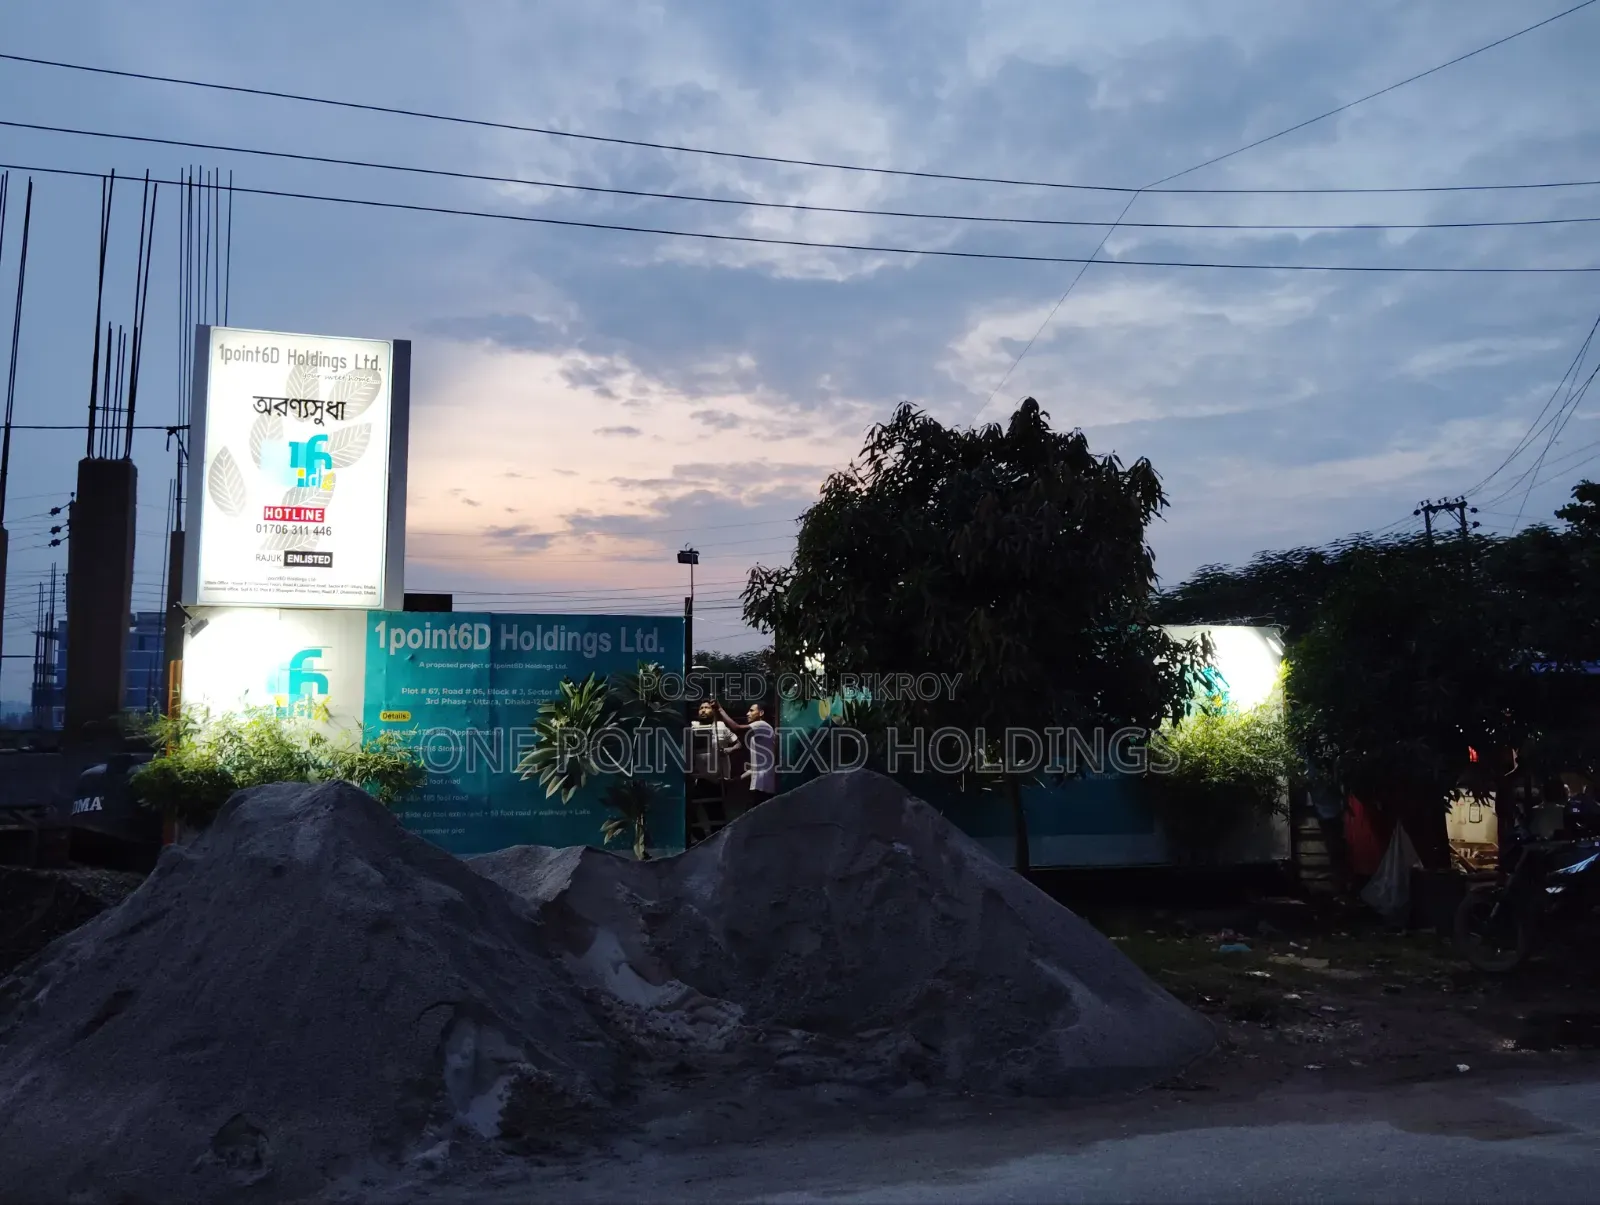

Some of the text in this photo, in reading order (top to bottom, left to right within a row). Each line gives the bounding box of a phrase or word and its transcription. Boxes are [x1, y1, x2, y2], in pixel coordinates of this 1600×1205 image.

[219, 343, 382, 372] 1point6D Holdings Ltd.
[252, 396, 347, 427] অরণ্যসুধা
[265, 507, 323, 521] HOTLINE
[255, 523, 332, 537] 01706 311 446
[255, 553, 331, 564] RAJUK ENLISTED
[375, 620, 665, 659] 1point6D Holdings Ltd.
[426, 661, 459, 669] proposed
[460, 661, 482, 670] project
[524, 663, 554, 671] Holdings
[402, 687, 418, 695] Plot
[428, 687, 440, 696] 67,
[442, 687, 463, 695] Road
[425, 697, 439, 705] 3rd
[441, 697, 466, 705] Phase
[382, 712, 409, 720] Details:
